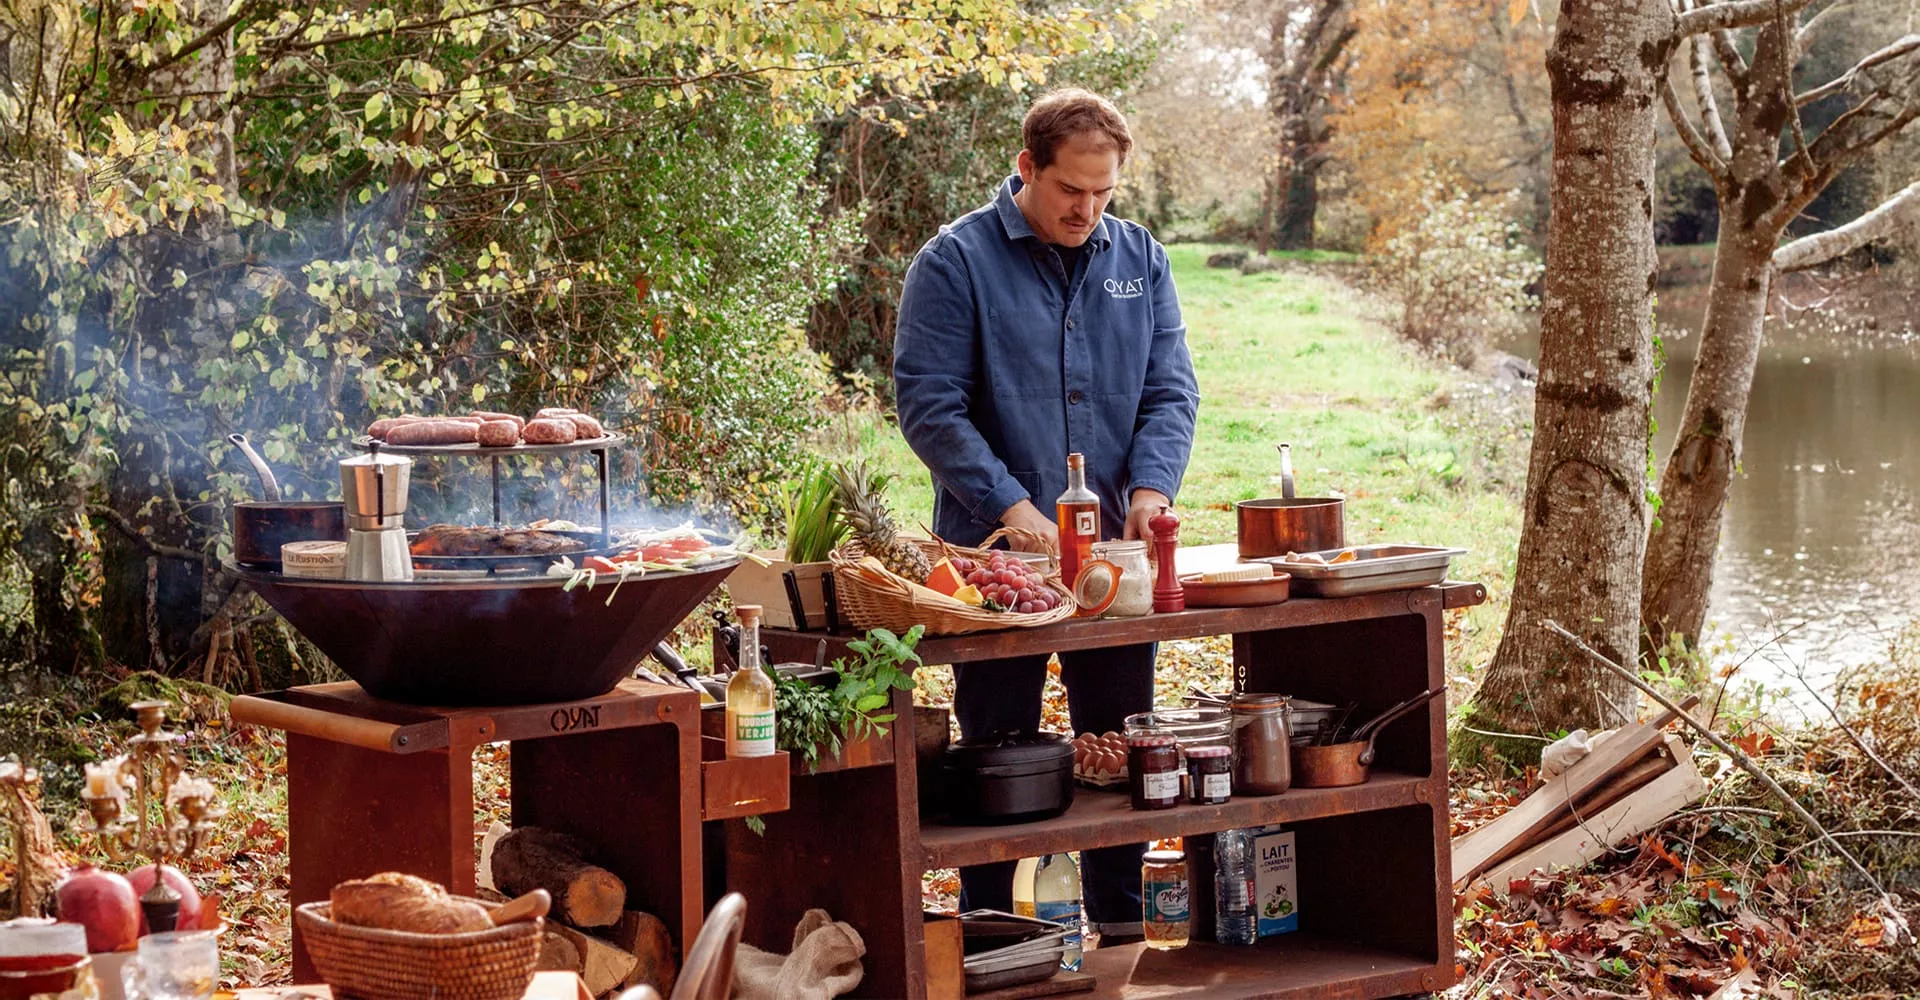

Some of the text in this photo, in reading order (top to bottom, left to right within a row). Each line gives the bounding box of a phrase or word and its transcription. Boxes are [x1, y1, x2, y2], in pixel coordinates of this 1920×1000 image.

[1103, 277, 1144, 294] OYAT
[551, 706, 601, 732] OYAT
[1262, 844, 1289, 860] LAIT
